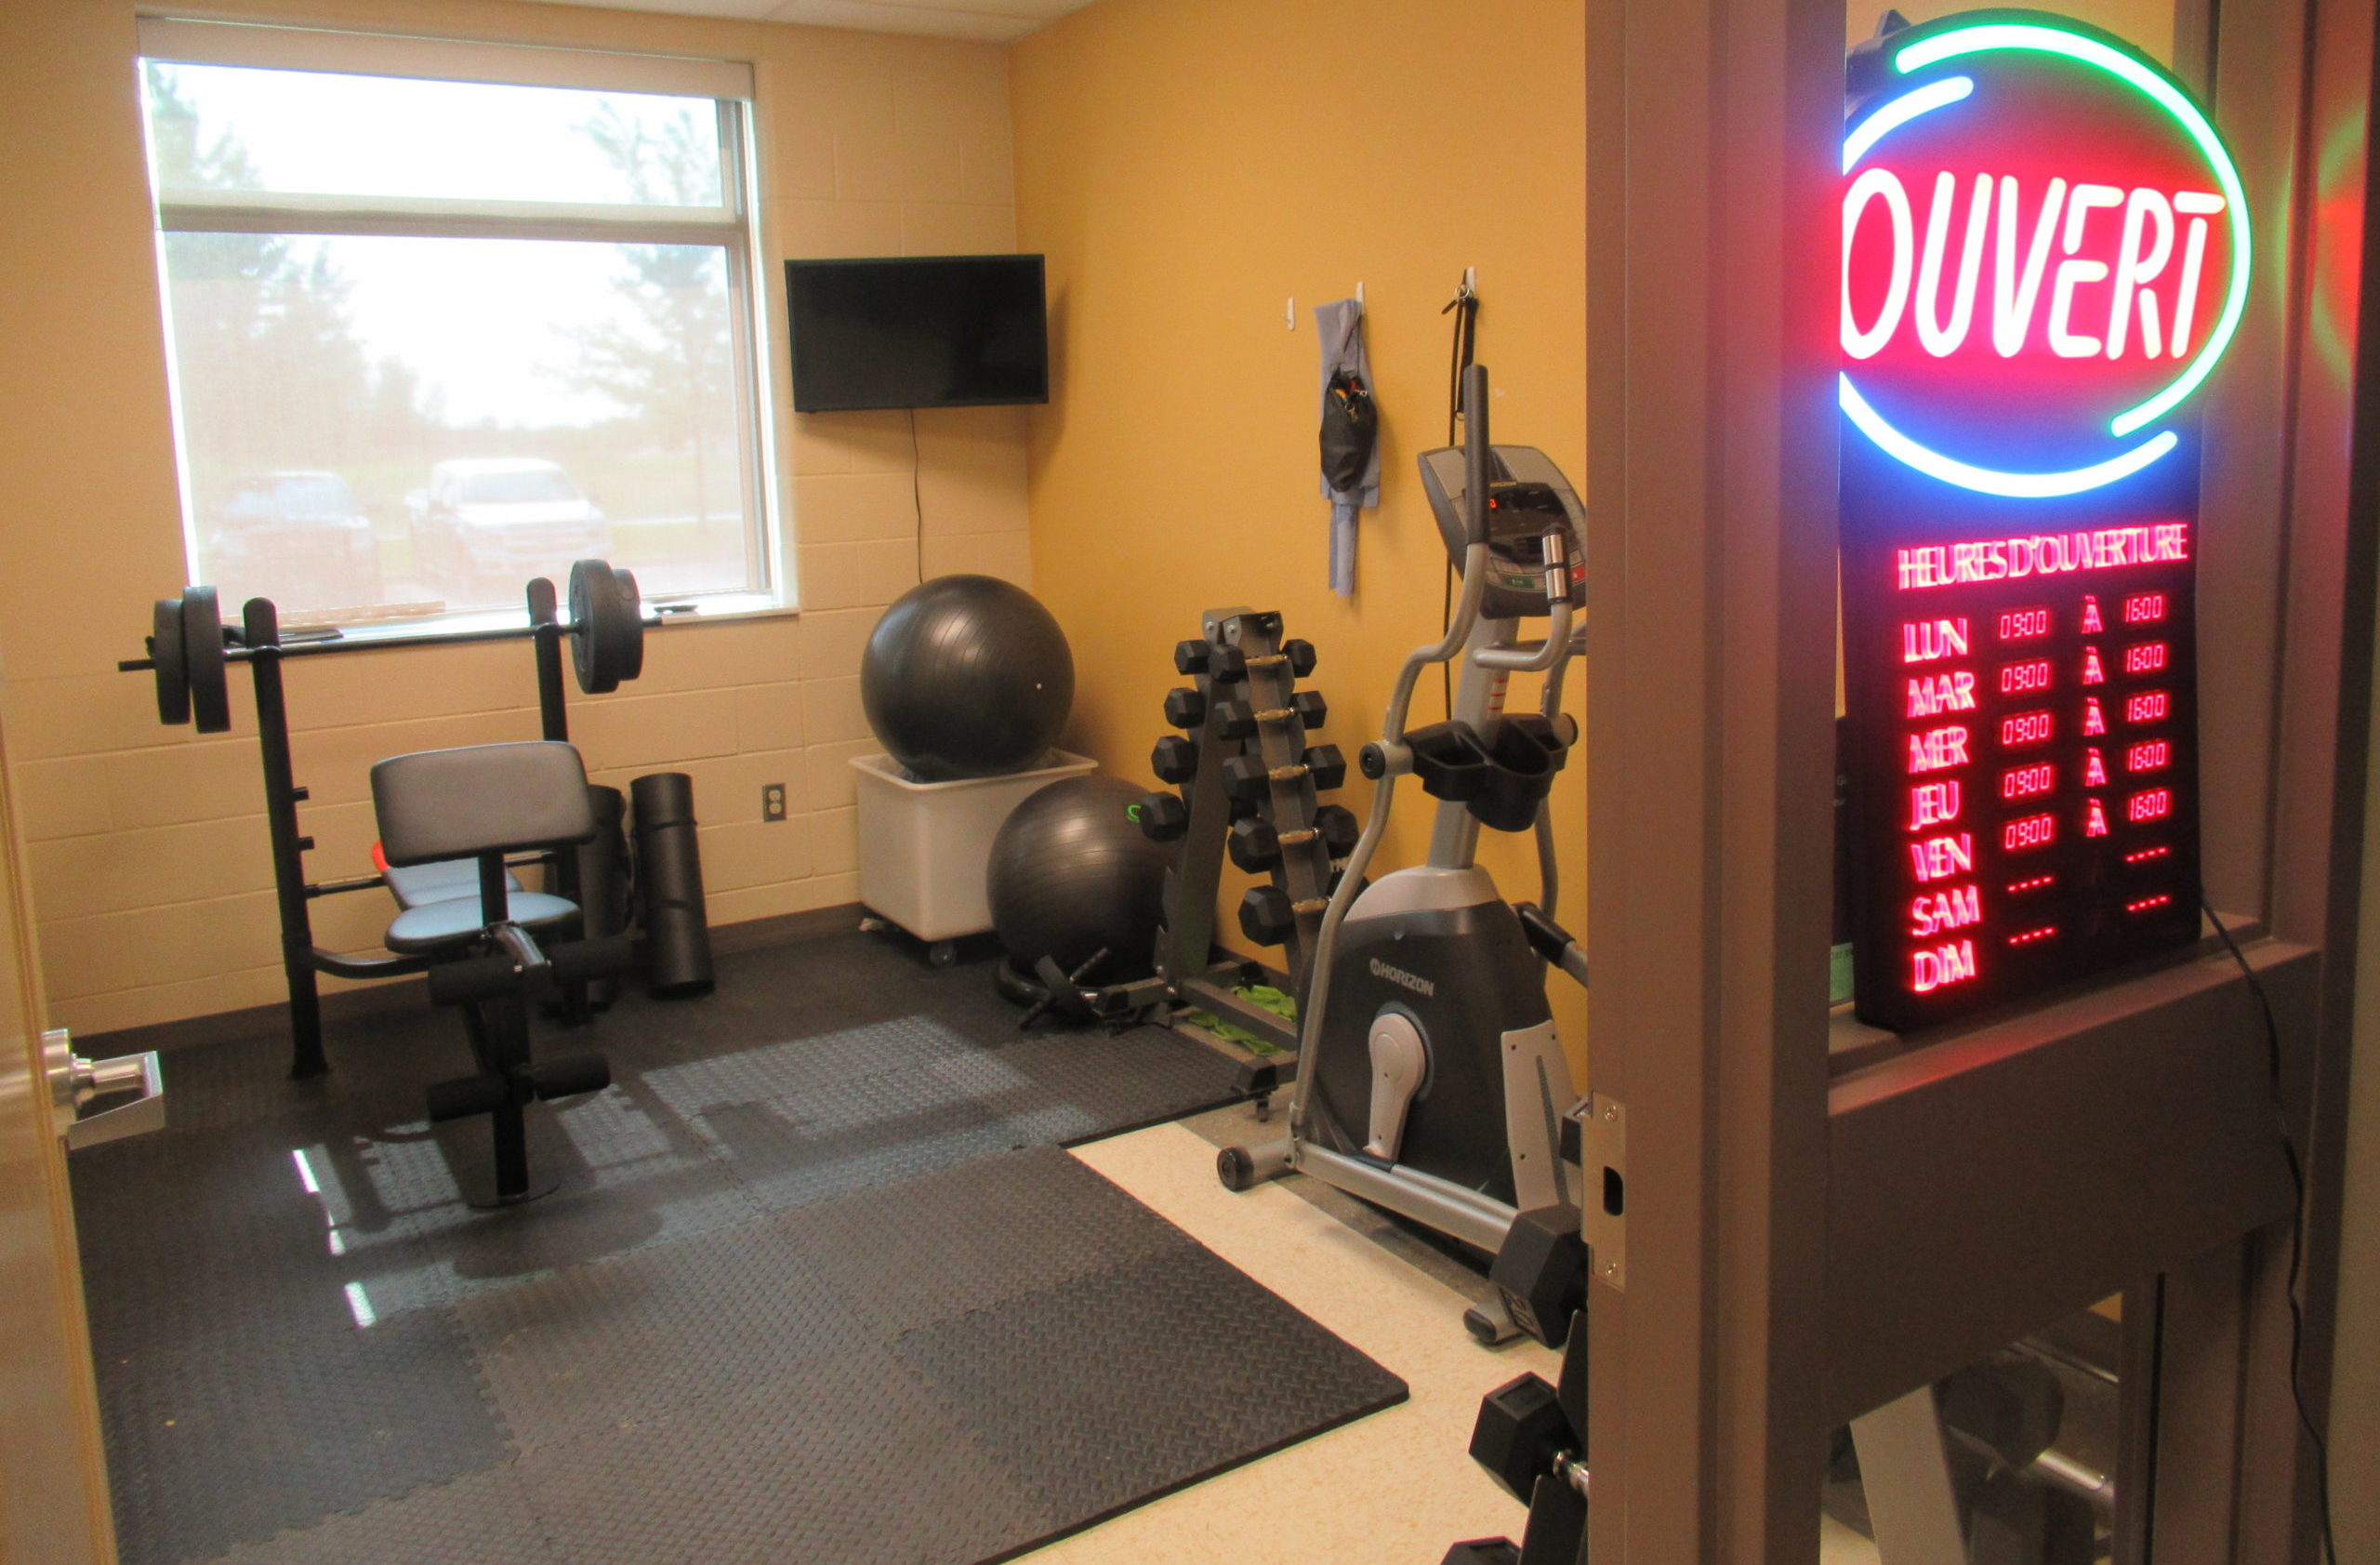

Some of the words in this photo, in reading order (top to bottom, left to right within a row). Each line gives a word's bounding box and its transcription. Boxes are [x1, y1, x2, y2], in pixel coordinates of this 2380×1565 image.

[1842, 168, 2226, 361] OUVERT
[1903, 617, 1968, 663] LUN
[2000, 610, 2047, 640] 09:00
[2081, 594, 2104, 635] À
[2125, 595, 2163, 624] 16:00
[1907, 671, 1976, 719] MAR
[2002, 662, 2048, 692] 09:00
[2082, 646, 2105, 685] À
[2126, 644, 2164, 673] 16:00
[1909, 725, 1969, 774] MER
[2003, 713, 2050, 745] 09:00
[2083, 697, 2107, 736] À
[2128, 694, 2165, 723] 16:00
[1910, 781, 1960, 831] JEU
[2004, 765, 2052, 799] 09:00
[2085, 748, 2108, 787] À
[2129, 742, 2166, 772] 16:00
[1911, 833, 1972, 882] VEN
[2005, 816, 2053, 850] 09:00
[2086, 798, 2109, 837] À
[2130, 791, 2167, 821] 16:00
[1912, 885, 1980, 936] SAM
[1380, 962, 1435, 998] HORIZON
[1913, 939, 1976, 992] DIM
